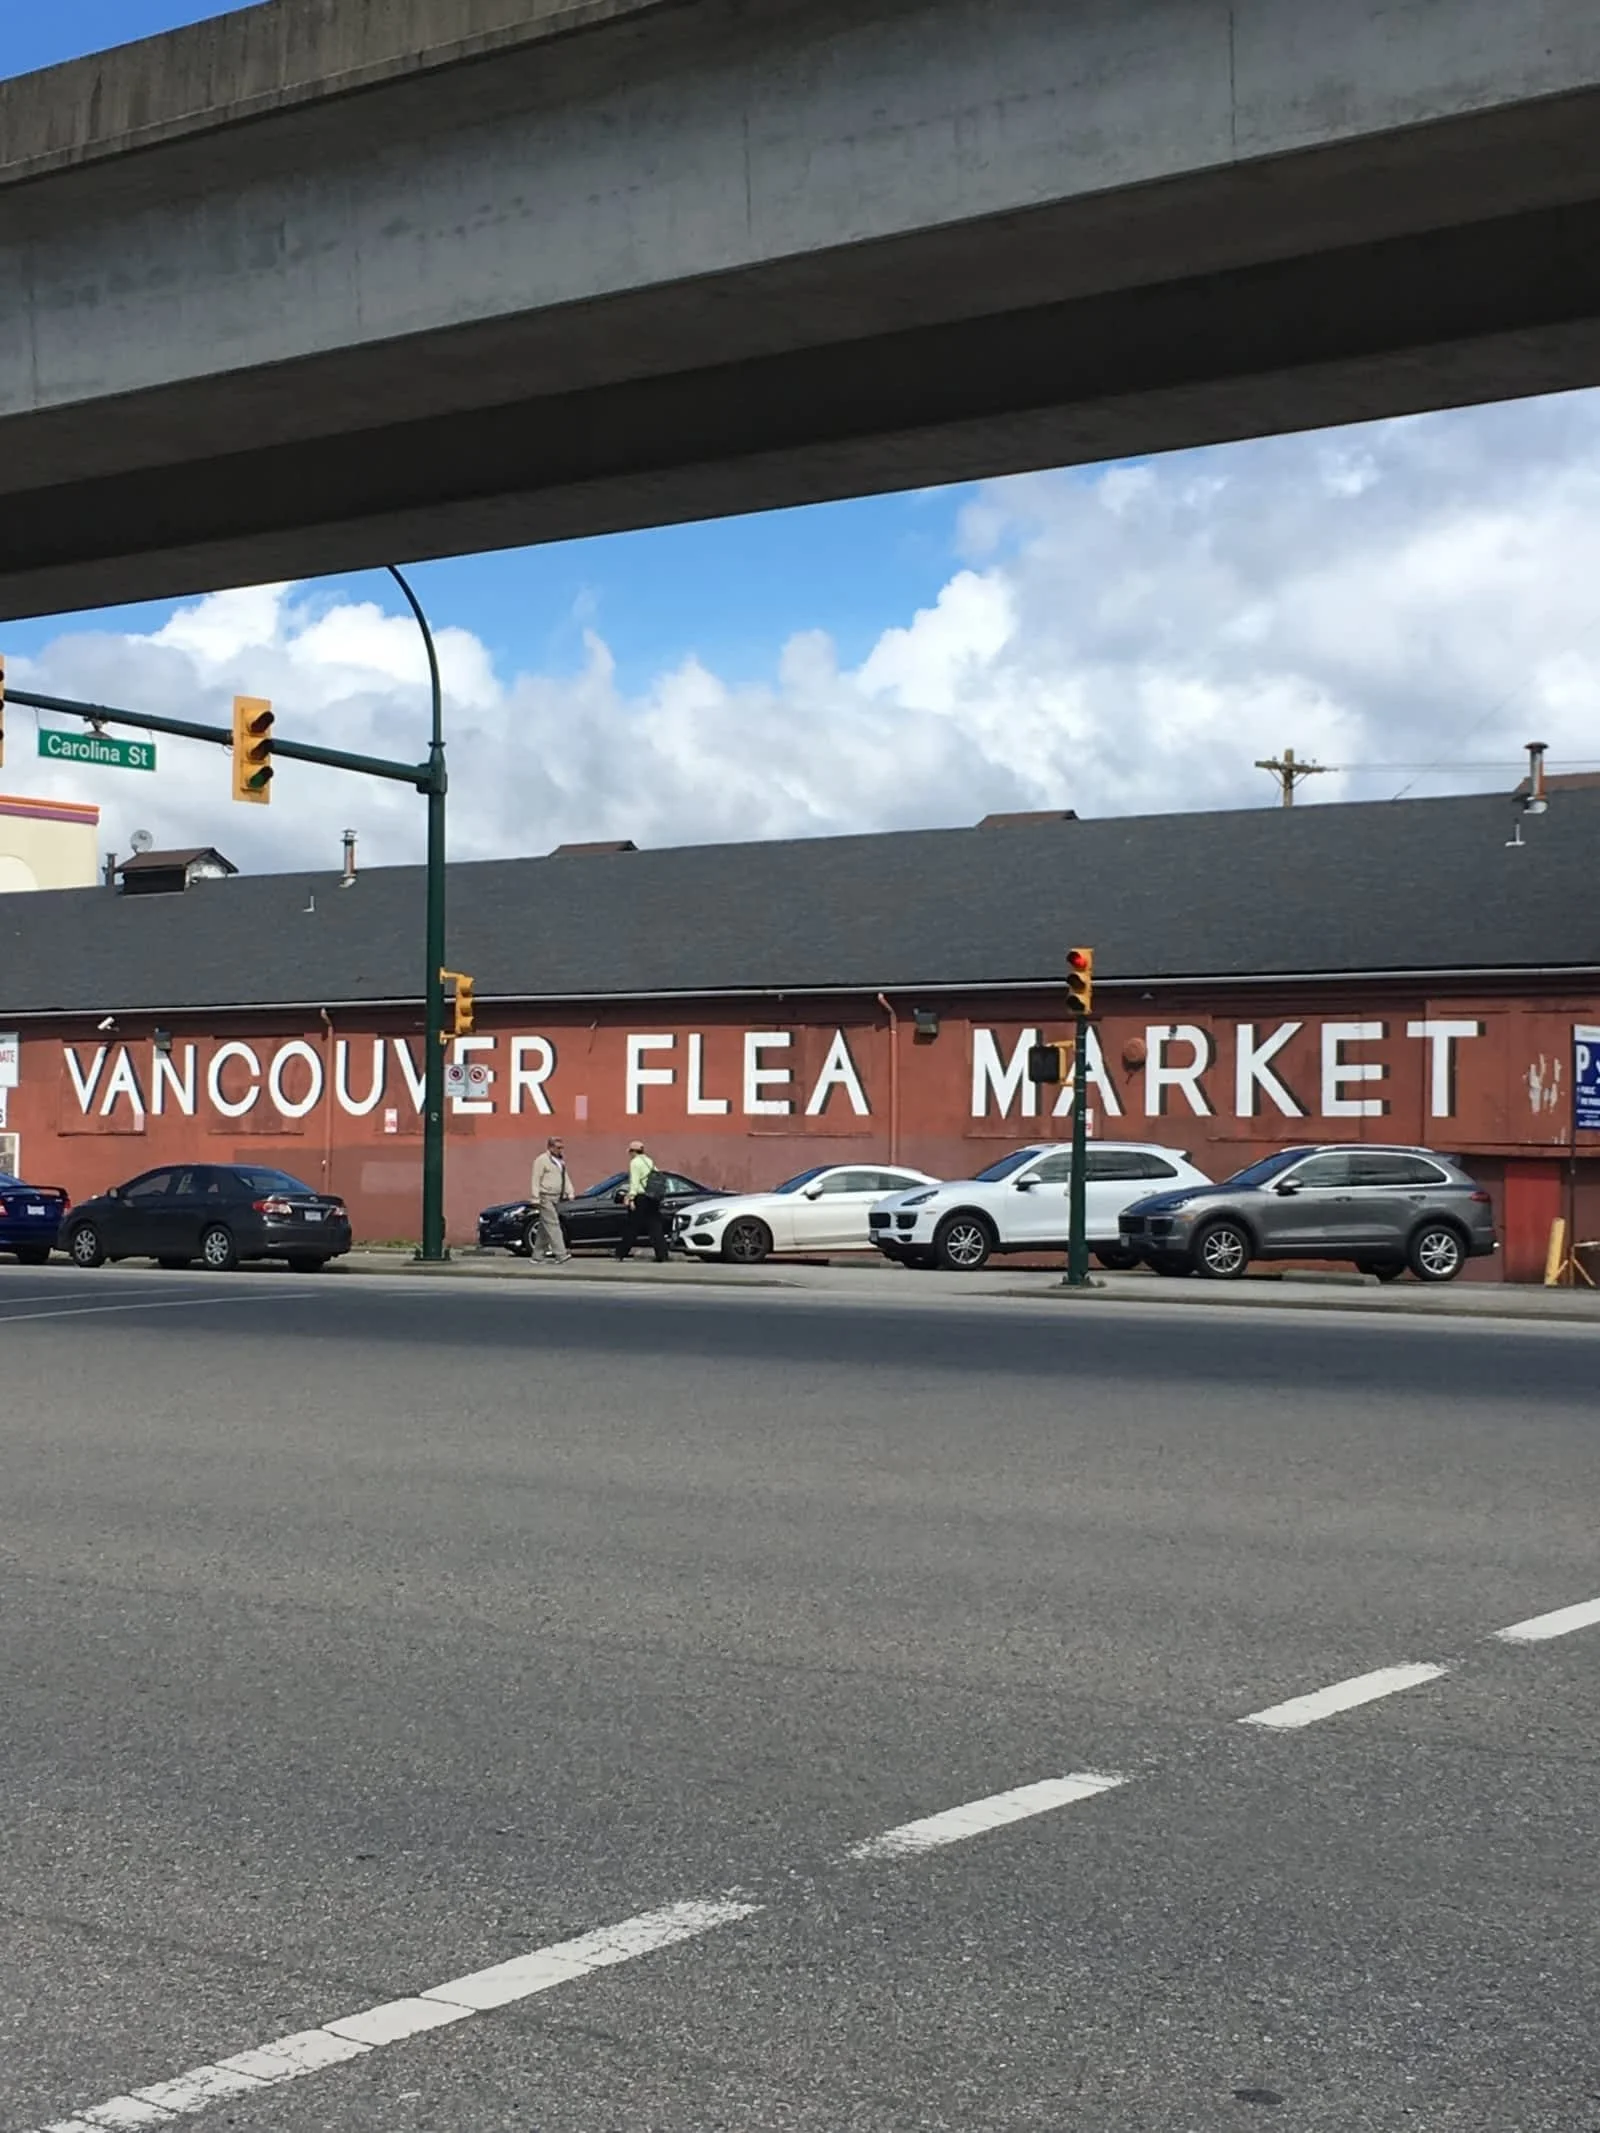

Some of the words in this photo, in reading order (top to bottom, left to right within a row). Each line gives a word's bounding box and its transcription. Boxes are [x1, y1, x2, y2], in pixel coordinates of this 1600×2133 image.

[48, 736, 121, 763] Carolina
[128, 746, 148, 766] St
[63, 1035, 555, 1118] VANCOUVER
[626, 1029, 870, 1116] FLEA
[970, 1020, 1479, 1120] MARKET
